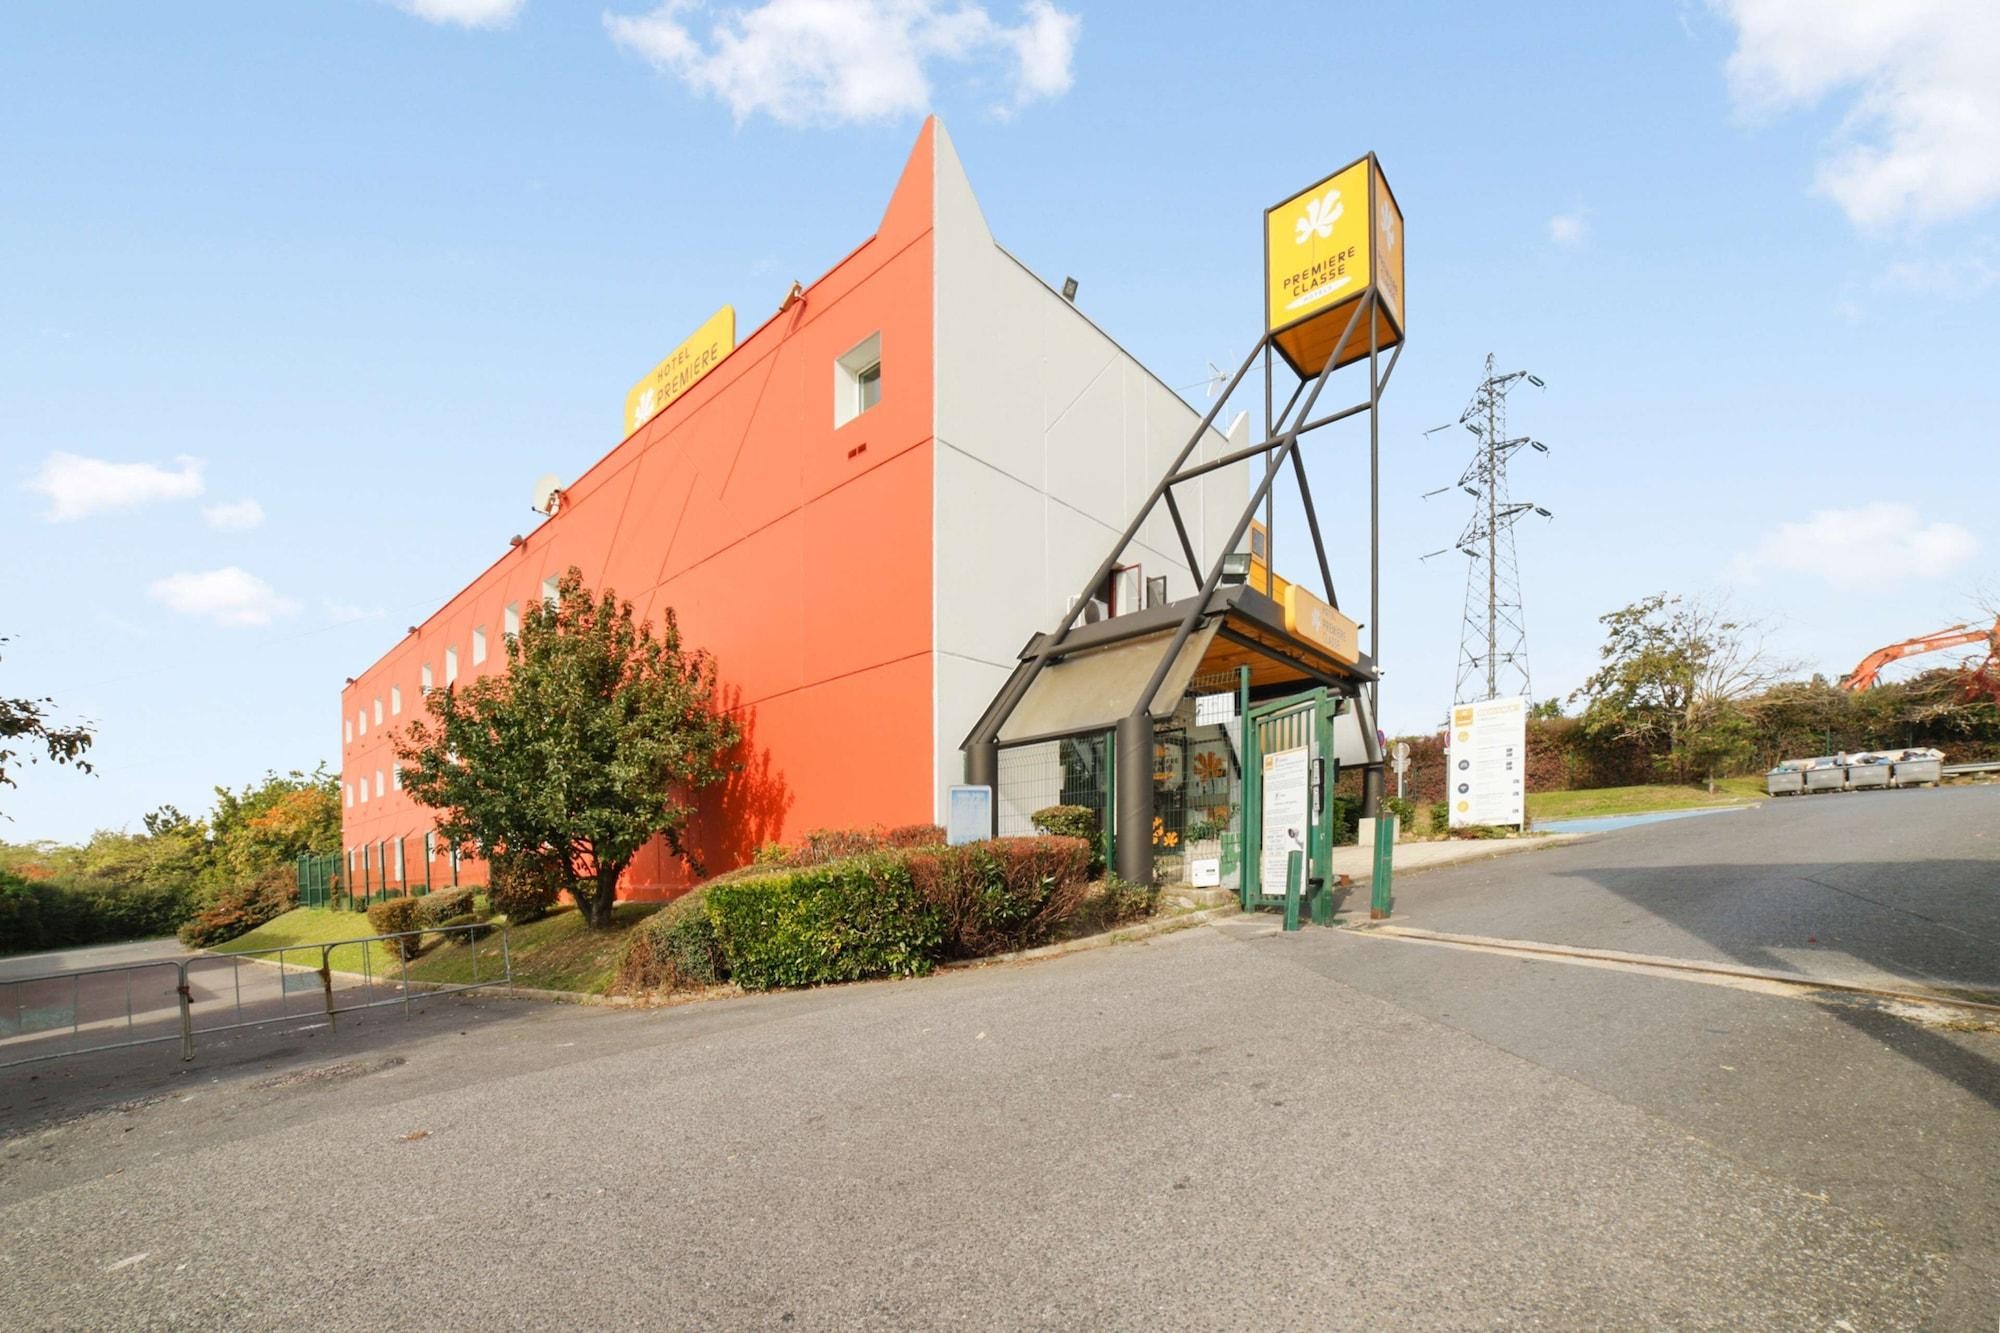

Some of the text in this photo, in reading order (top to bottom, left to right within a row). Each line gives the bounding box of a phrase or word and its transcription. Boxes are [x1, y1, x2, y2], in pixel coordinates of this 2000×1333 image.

[1283, 246, 1355, 290] PREMIERE
[1293, 264, 1345, 297] CLASSE
[656, 342, 719, 406] PREMIERE
[657, 347, 690, 384] HOTEL
